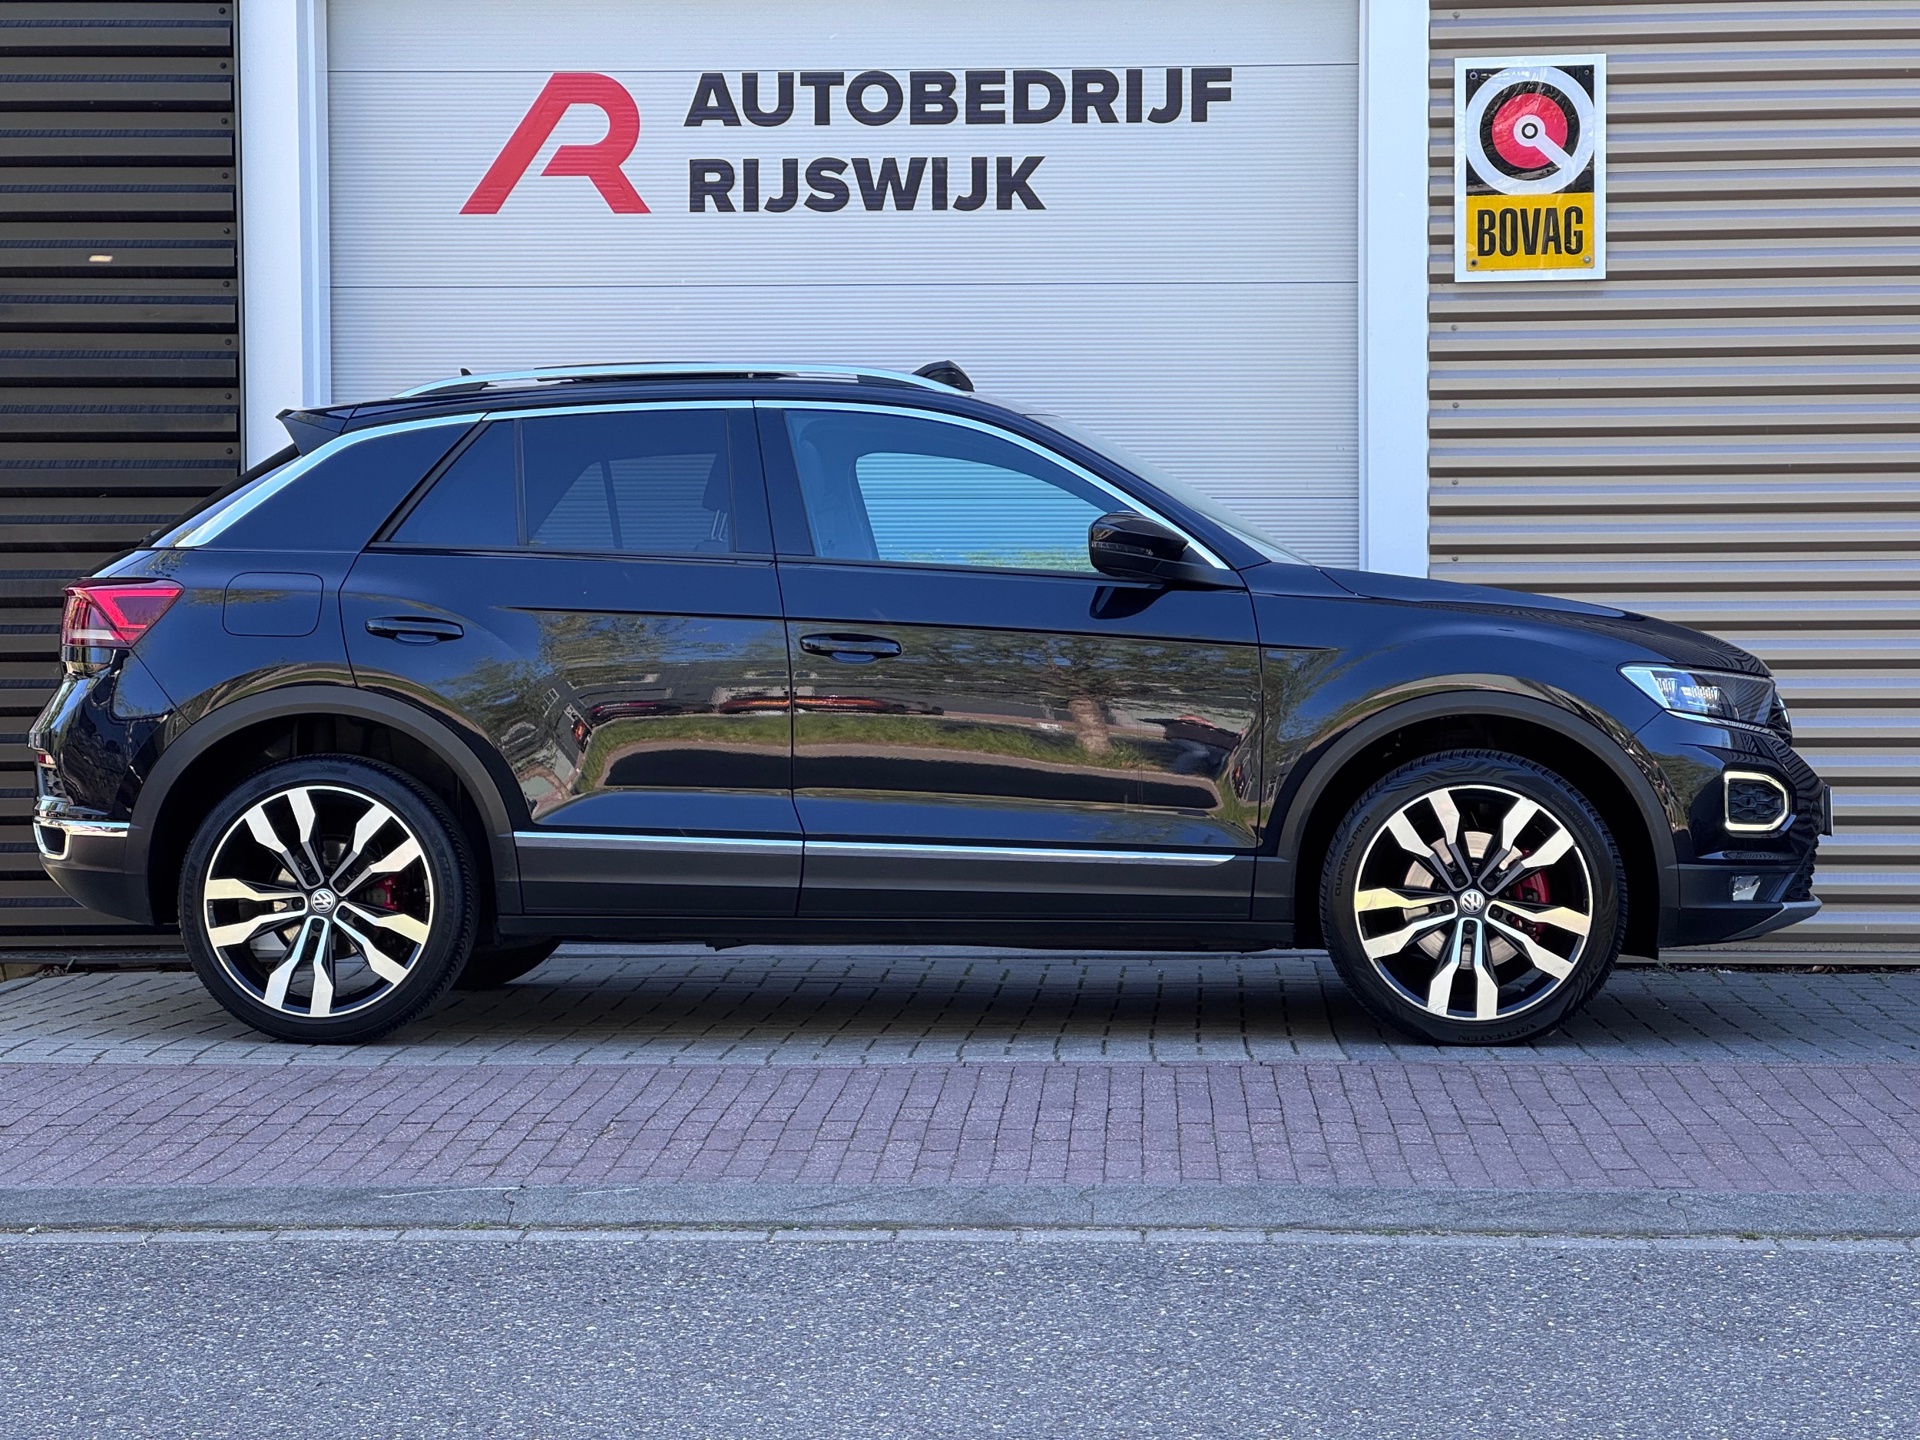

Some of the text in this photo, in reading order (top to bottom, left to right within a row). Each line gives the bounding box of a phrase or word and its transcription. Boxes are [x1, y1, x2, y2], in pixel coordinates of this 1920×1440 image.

[683, 67, 1233, 128] AUTOBEDRIJF
[688, 155, 1047, 213] RIJSWIJK
[1477, 206, 1584, 257] BOVAG
[1335, 815, 1370, 896] QUATRAC PRO
[1551, 793, 1601, 857] GIUGIARO DESIGN
